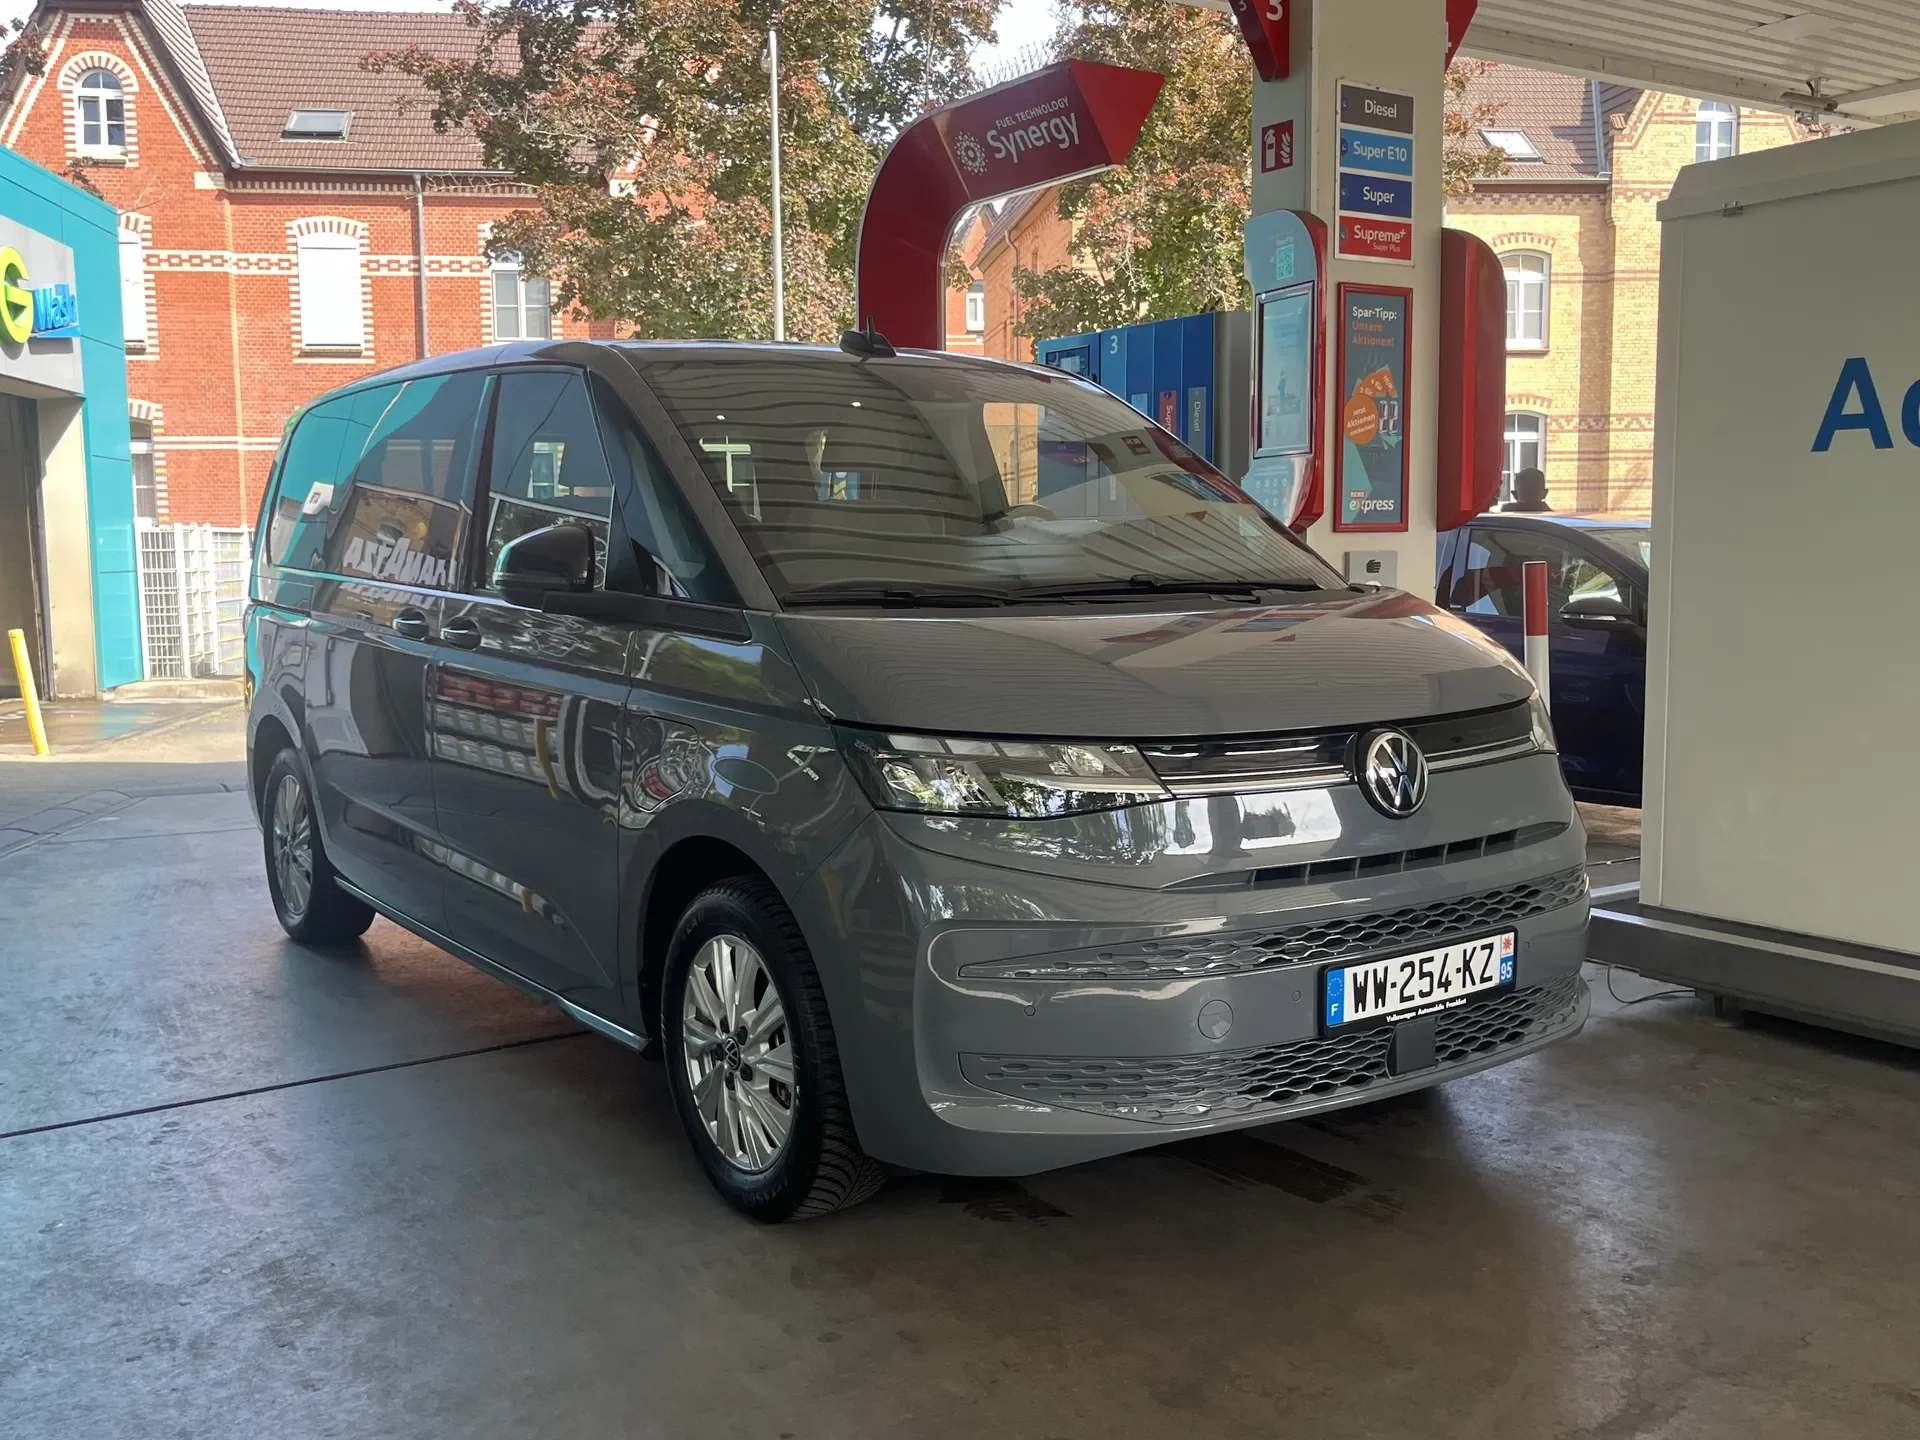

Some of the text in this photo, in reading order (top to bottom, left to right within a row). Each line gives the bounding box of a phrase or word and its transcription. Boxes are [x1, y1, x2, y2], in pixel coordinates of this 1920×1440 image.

[995, 96, 1069, 130] FUEL TECHNOLOGY
[1364, 99, 1397, 118] Diesel
[986, 112, 1079, 164] Synergy
[1353, 141, 1407, 162] Super E10
[1363, 186, 1394, 206] Super
[1372, 242, 1401, 253] Super Plus
[32, 283, 78, 331] Wash
[1352, 306, 1397, 322] Spar-Tipp:
[1352, 321, 1383, 333] Unsere
[1109, 334, 1118, 355] 3
[1352, 334, 1395, 348] Aktionen!
[1166, 404, 1174, 432] Supre
[1349, 499, 1395, 514] express
[1352, 942, 1494, 1014] WW-254-KZ
[1500, 962, 1513, 980] 95
[1331, 1003, 1339, 1017] F
